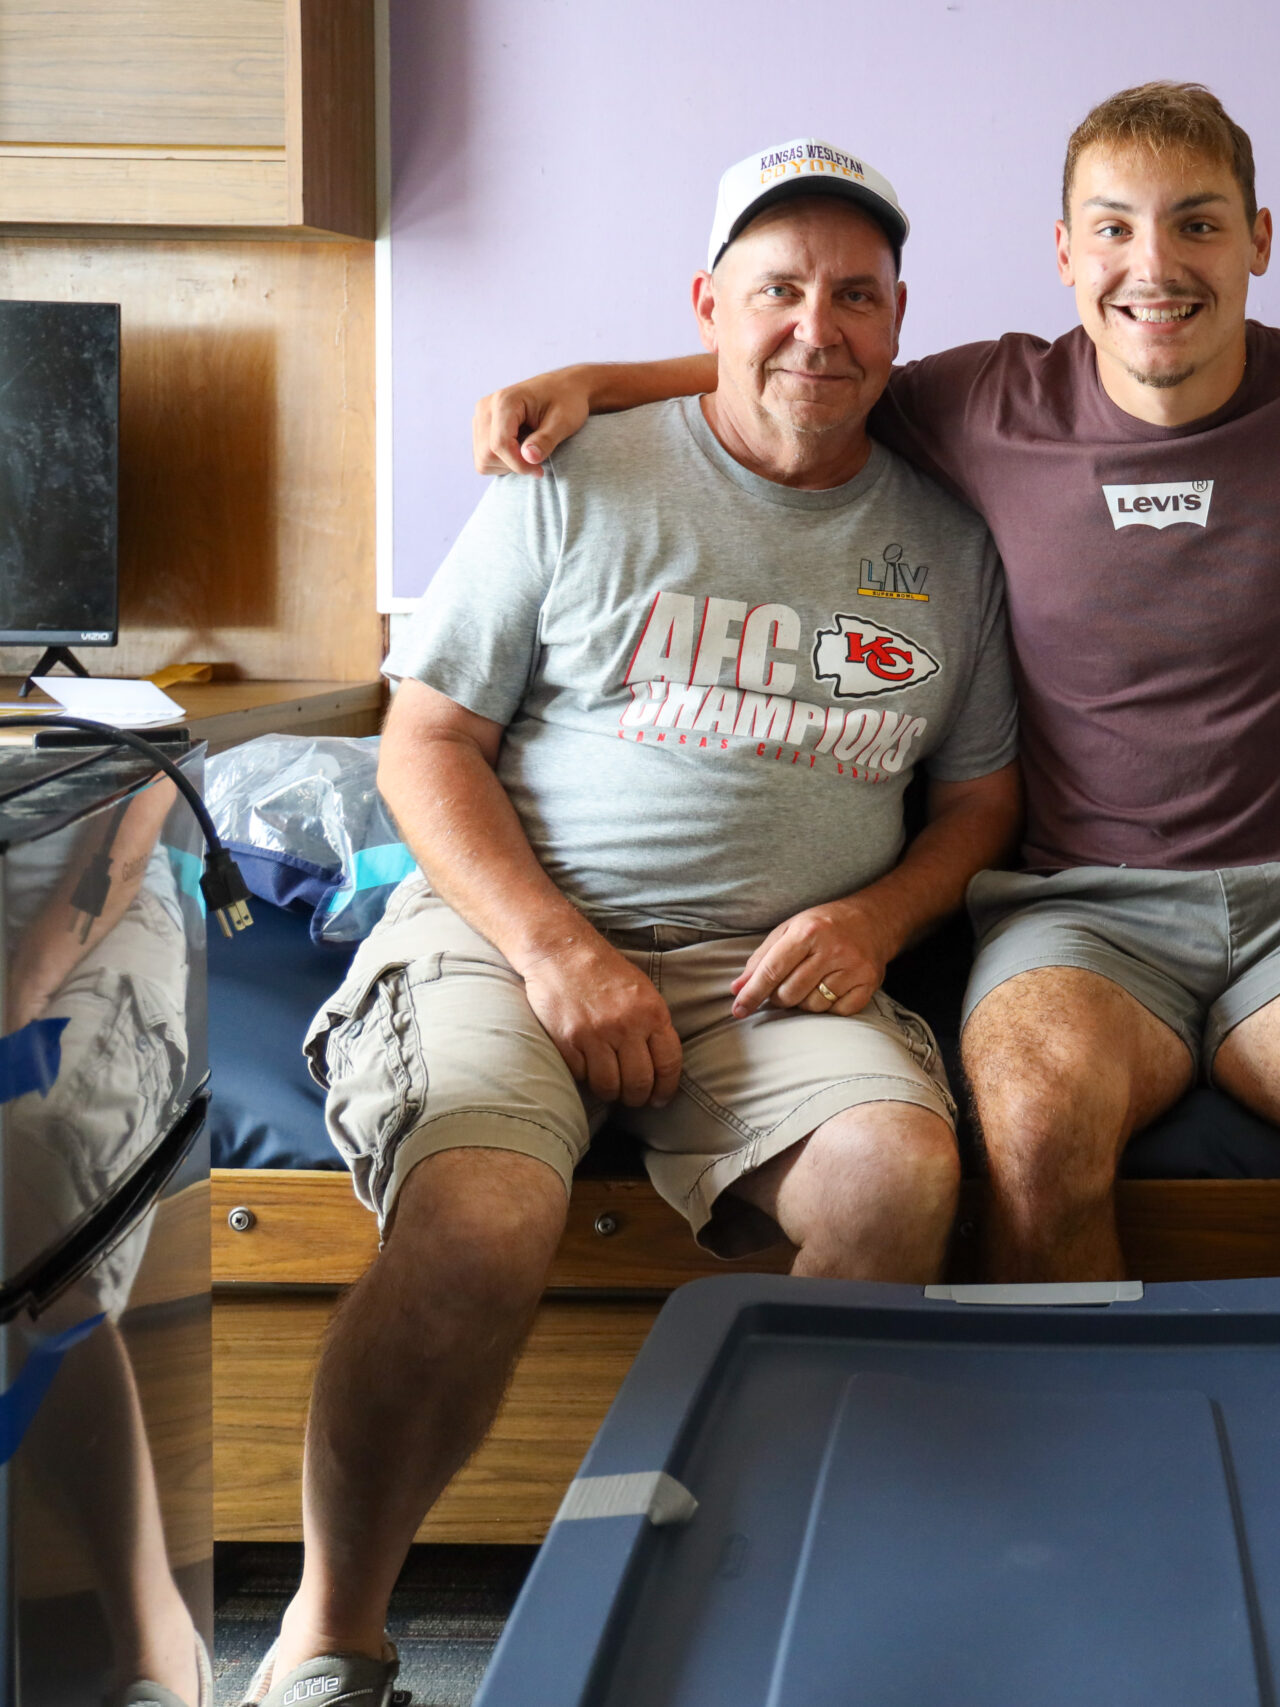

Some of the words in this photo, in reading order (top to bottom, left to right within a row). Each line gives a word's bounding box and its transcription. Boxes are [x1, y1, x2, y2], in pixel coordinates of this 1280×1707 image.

[760, 145, 803, 170] KANSAS
[806, 144, 864, 175] WESLEYAN
[859, 558, 929, 594] LIV
[872, 590, 894, 598] SUPER
[80, 632, 110, 641] VIZIO
[622, 591, 801, 696] AFC
[844, 631, 915, 682] KC
[618, 683, 927, 773] CHAMPIONS
[617, 729, 729, 749] KANSAS
[755, 742, 817, 768] CITY
[283, 1675, 340, 1706] dude
